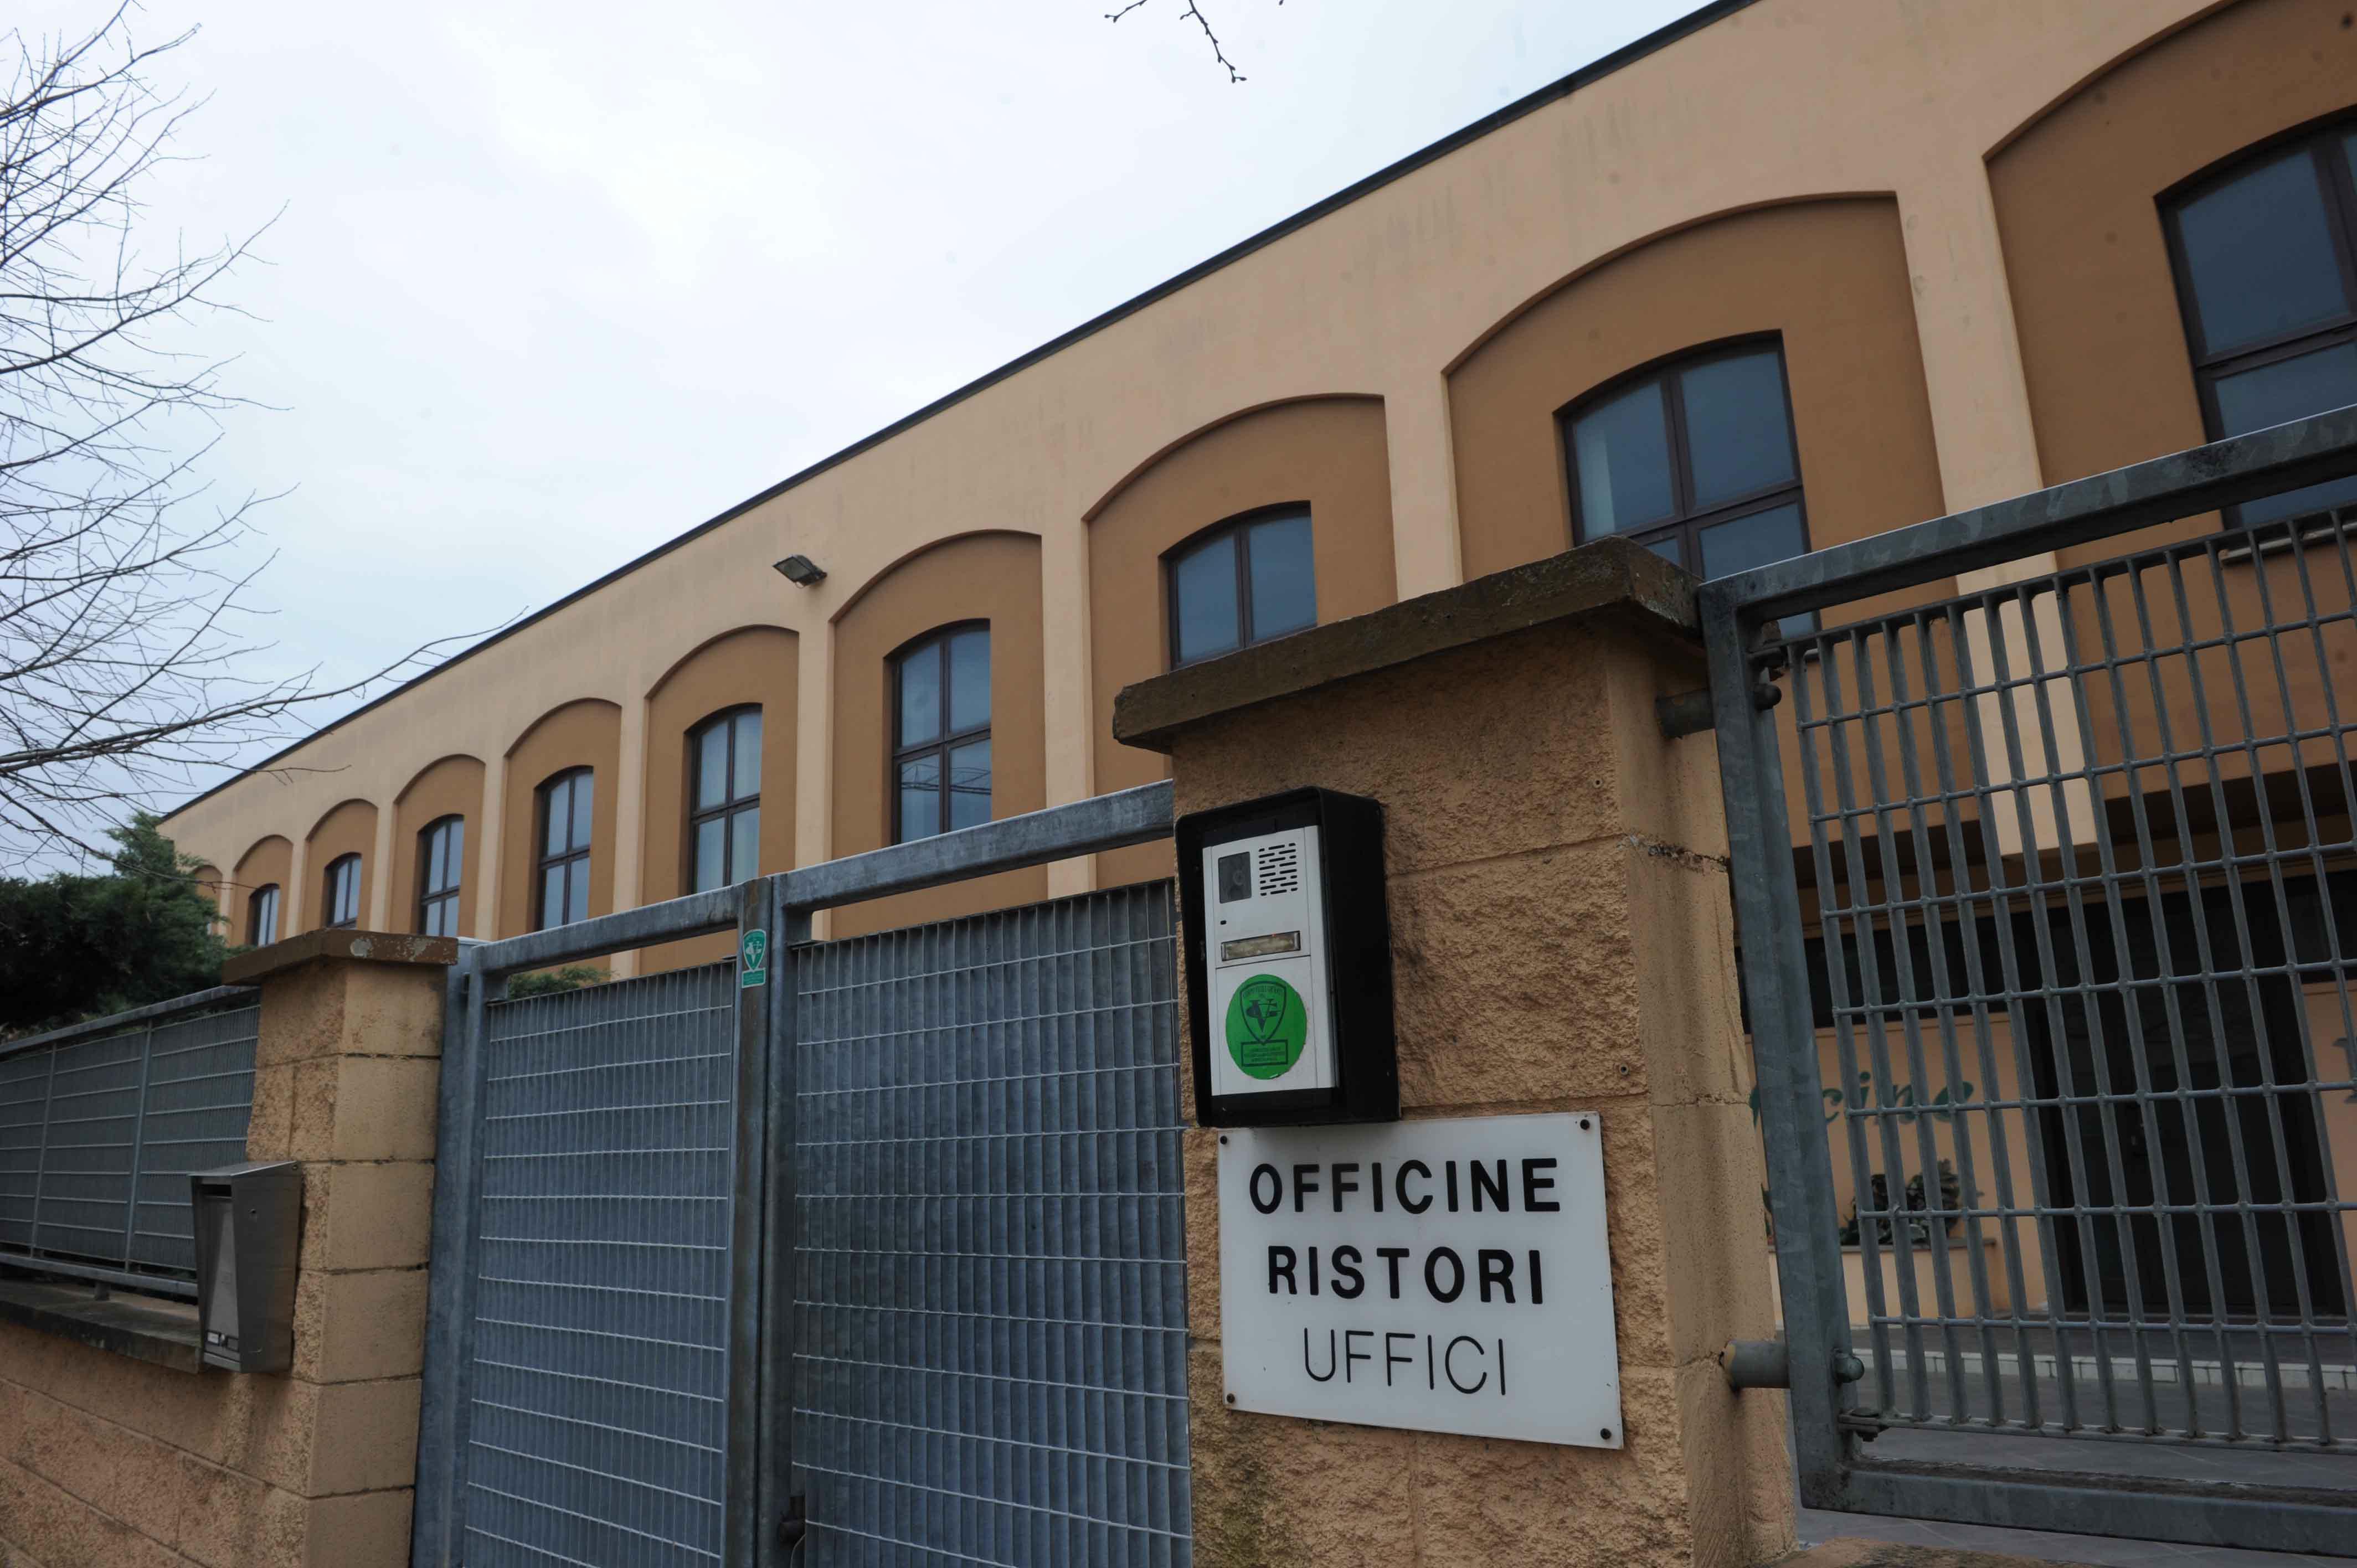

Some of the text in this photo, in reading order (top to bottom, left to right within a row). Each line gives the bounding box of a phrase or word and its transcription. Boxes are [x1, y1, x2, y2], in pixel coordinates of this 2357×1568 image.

[1249, 1158, 1561, 1215] OFFICINE
[1268, 1245, 1543, 1304] RISTORI
[1304, 1327, 1506, 1396] UFFICI
